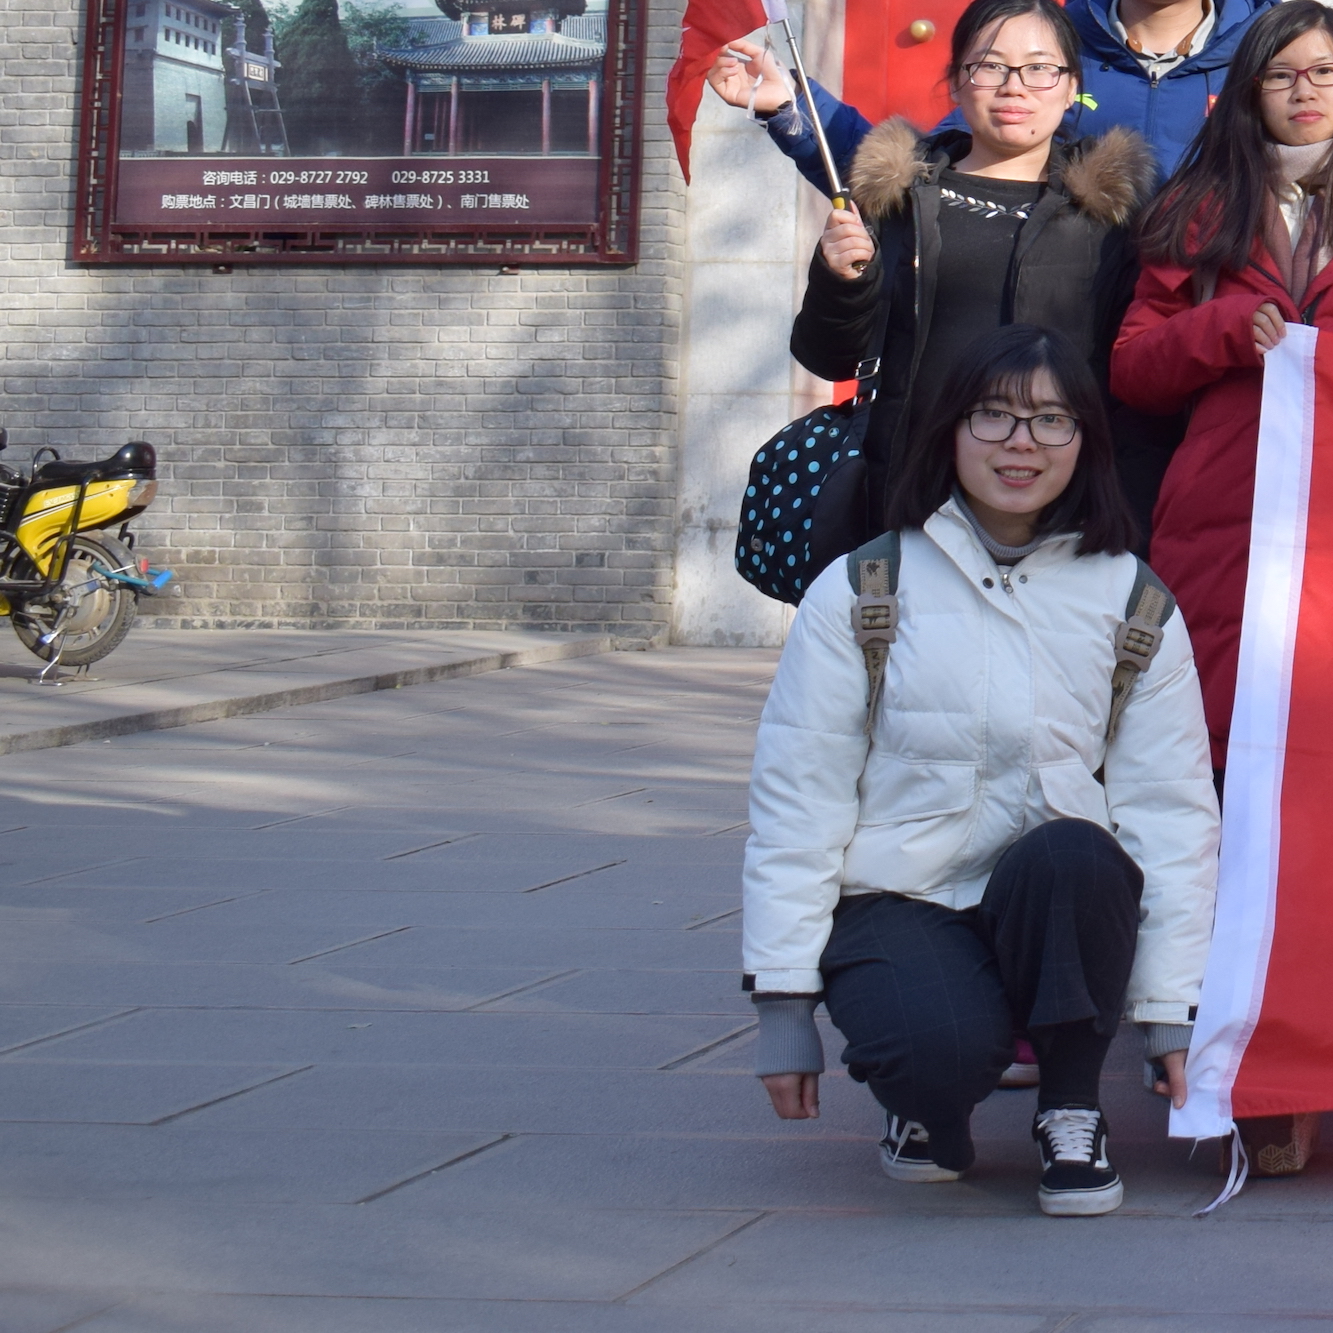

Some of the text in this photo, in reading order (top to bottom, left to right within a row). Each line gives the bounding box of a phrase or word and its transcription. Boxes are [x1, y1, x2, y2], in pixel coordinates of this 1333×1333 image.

[336, 171, 368, 184] 2792
[392, 171, 454, 184] 029-8725
[458, 170, 489, 183] 3331
